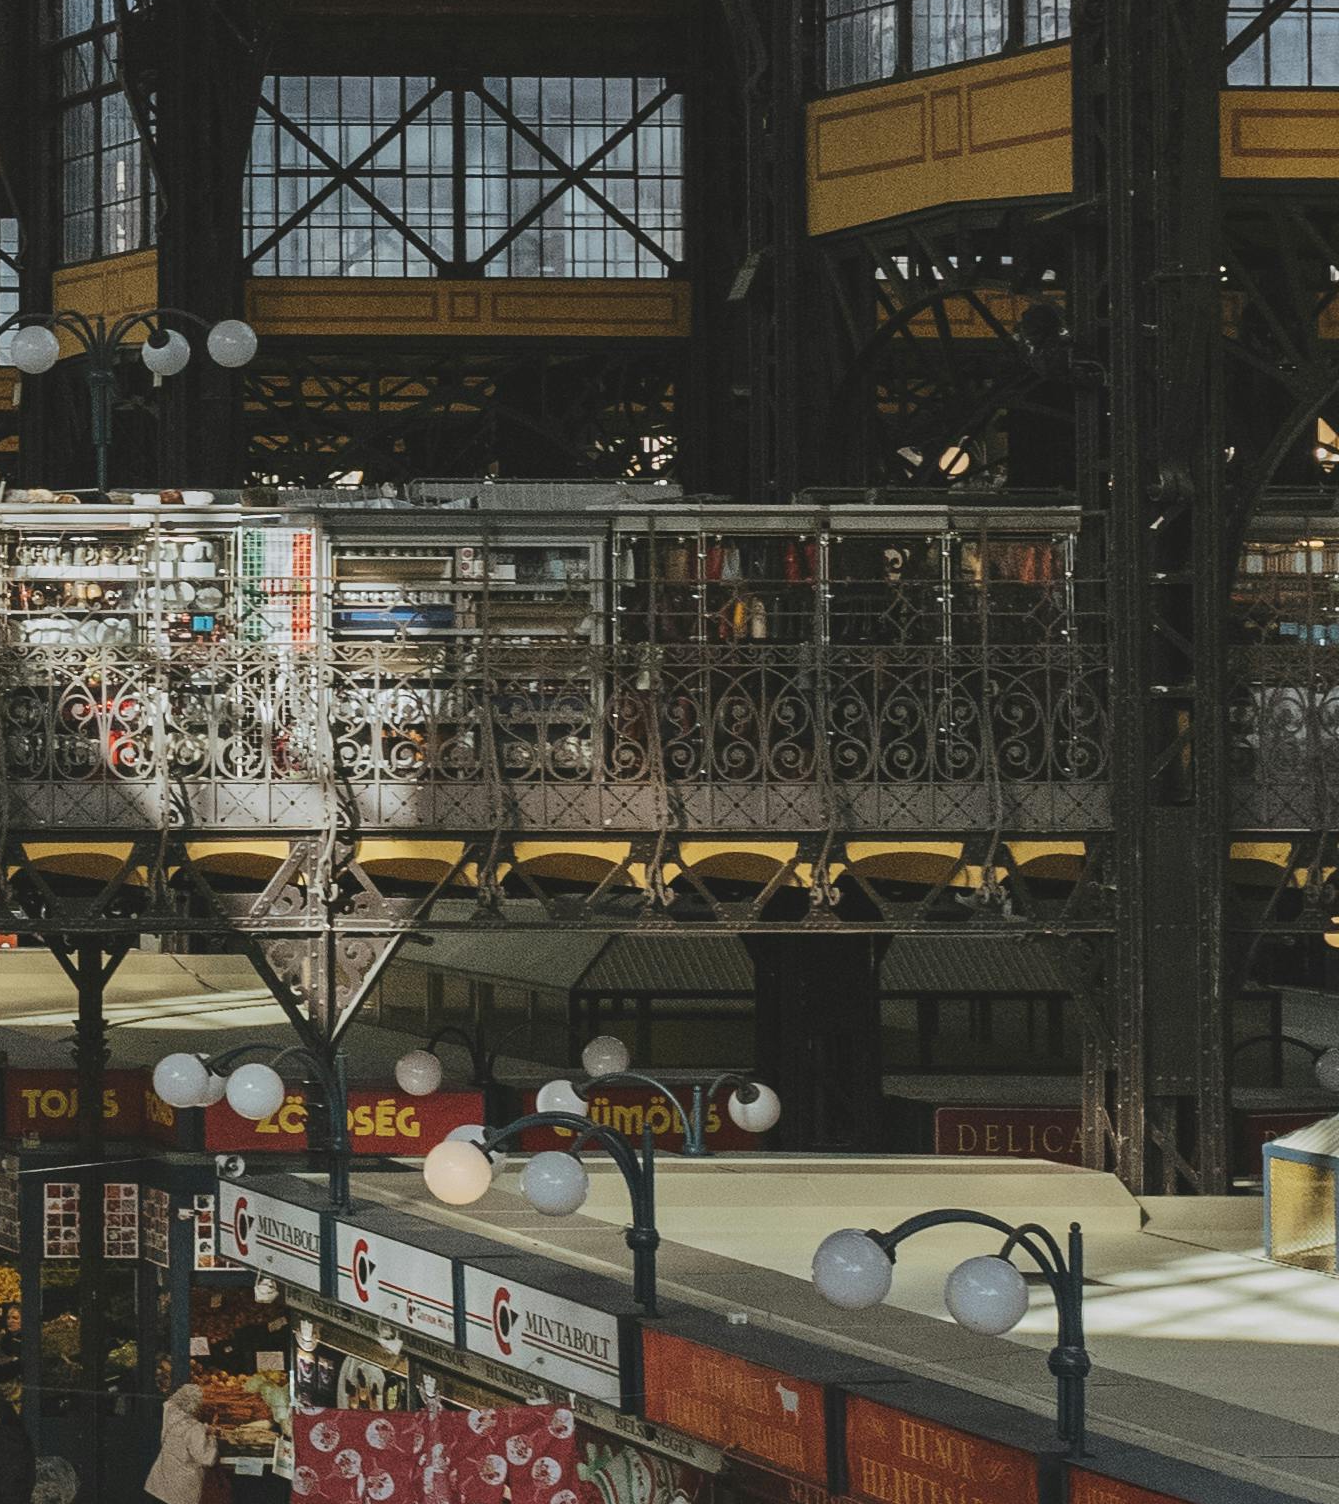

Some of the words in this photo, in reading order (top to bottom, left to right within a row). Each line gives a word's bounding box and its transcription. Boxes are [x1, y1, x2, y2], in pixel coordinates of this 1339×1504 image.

[21, 1088, 120, 1119] TOJS
[255, 1095, 421, 1138] ZÖSÉG
[524, 1310, 612, 1361] MINTABOLT
